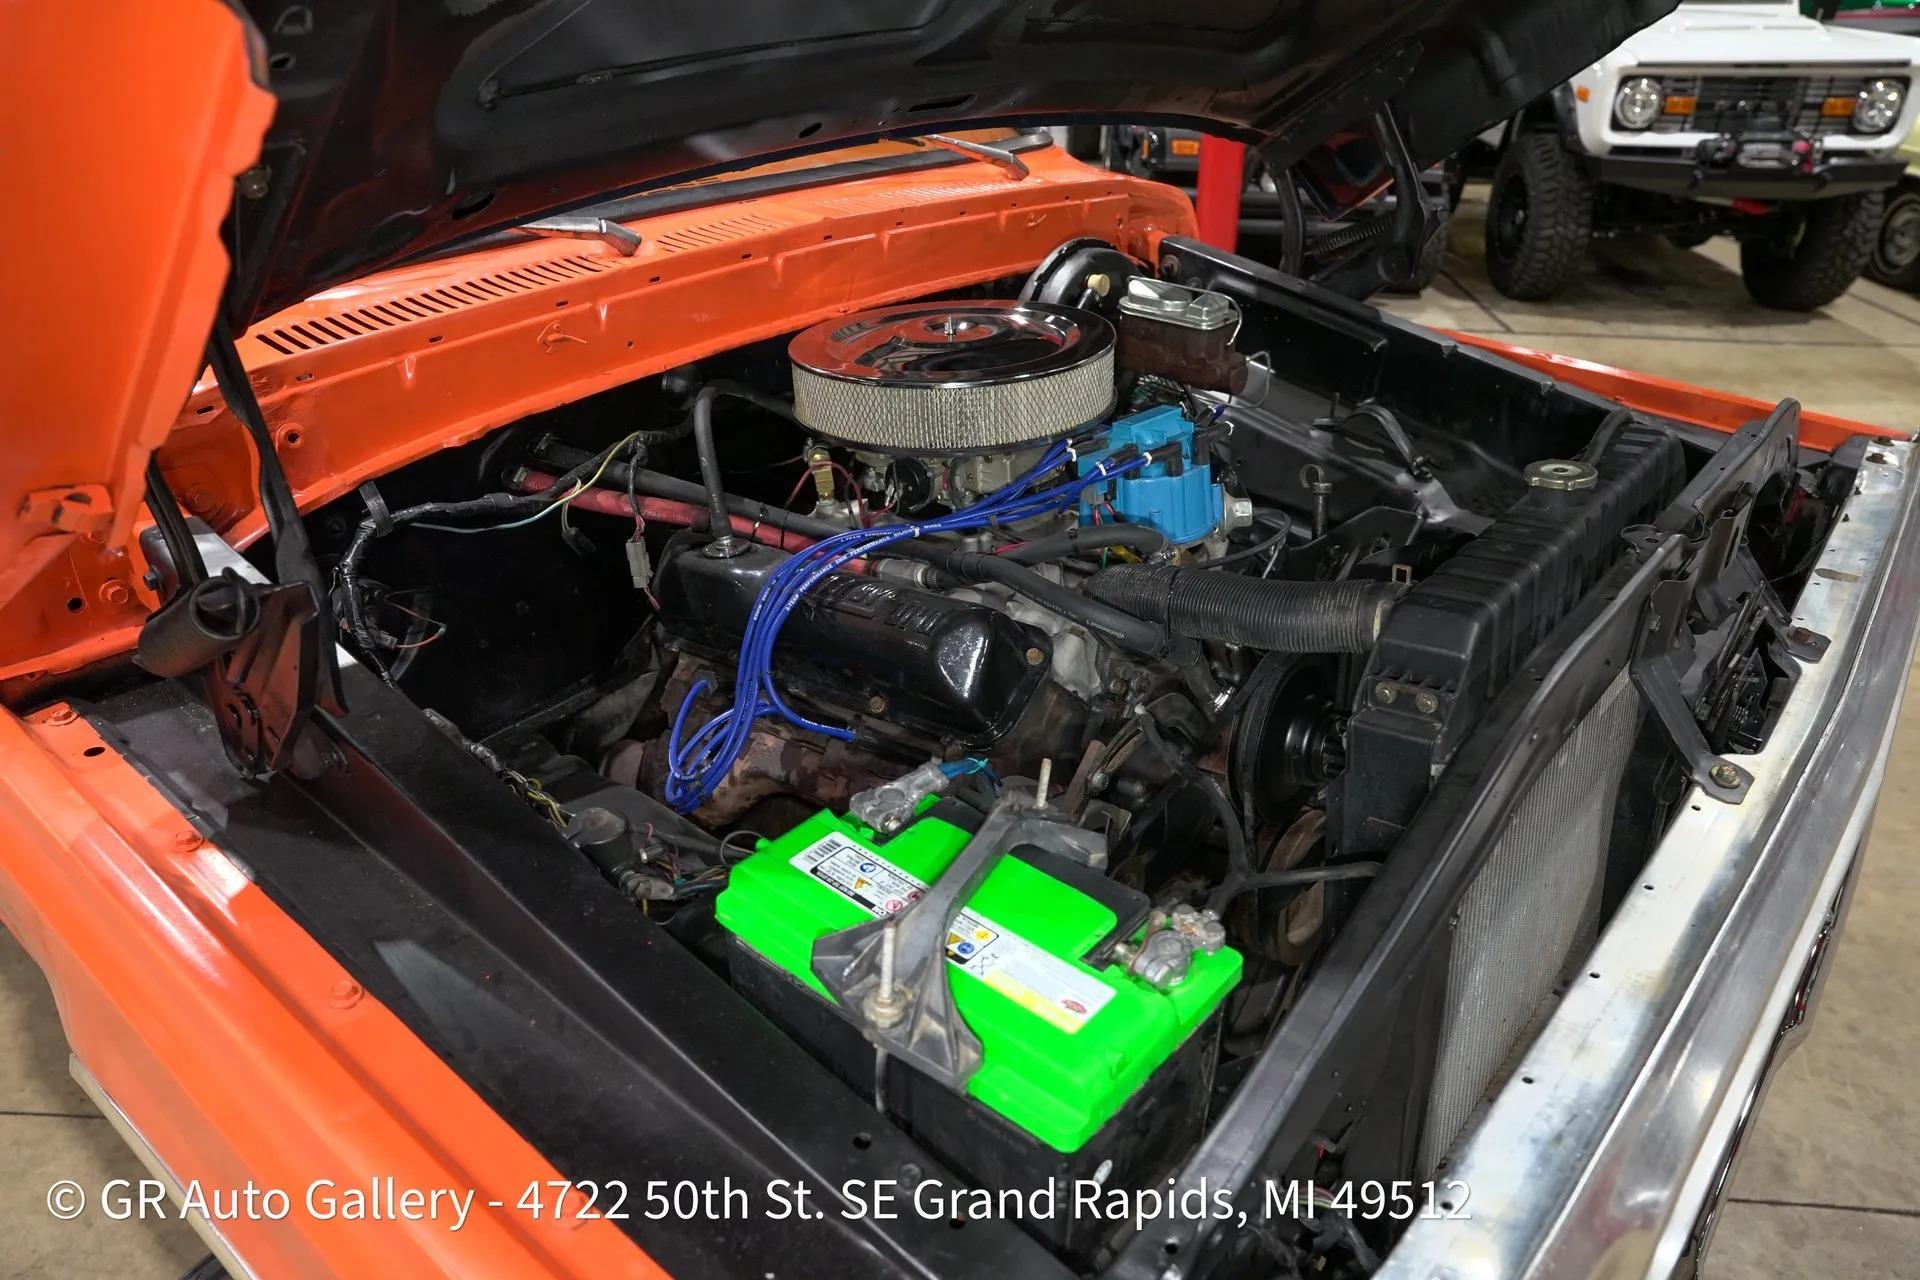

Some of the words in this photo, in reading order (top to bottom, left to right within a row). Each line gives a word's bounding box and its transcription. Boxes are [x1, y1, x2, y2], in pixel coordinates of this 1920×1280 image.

[786, 593, 800, 611] A-TEAM
[799, 564, 834, 593] PERFORMANCE
[849, 535, 892, 557] PERFORMANCE
